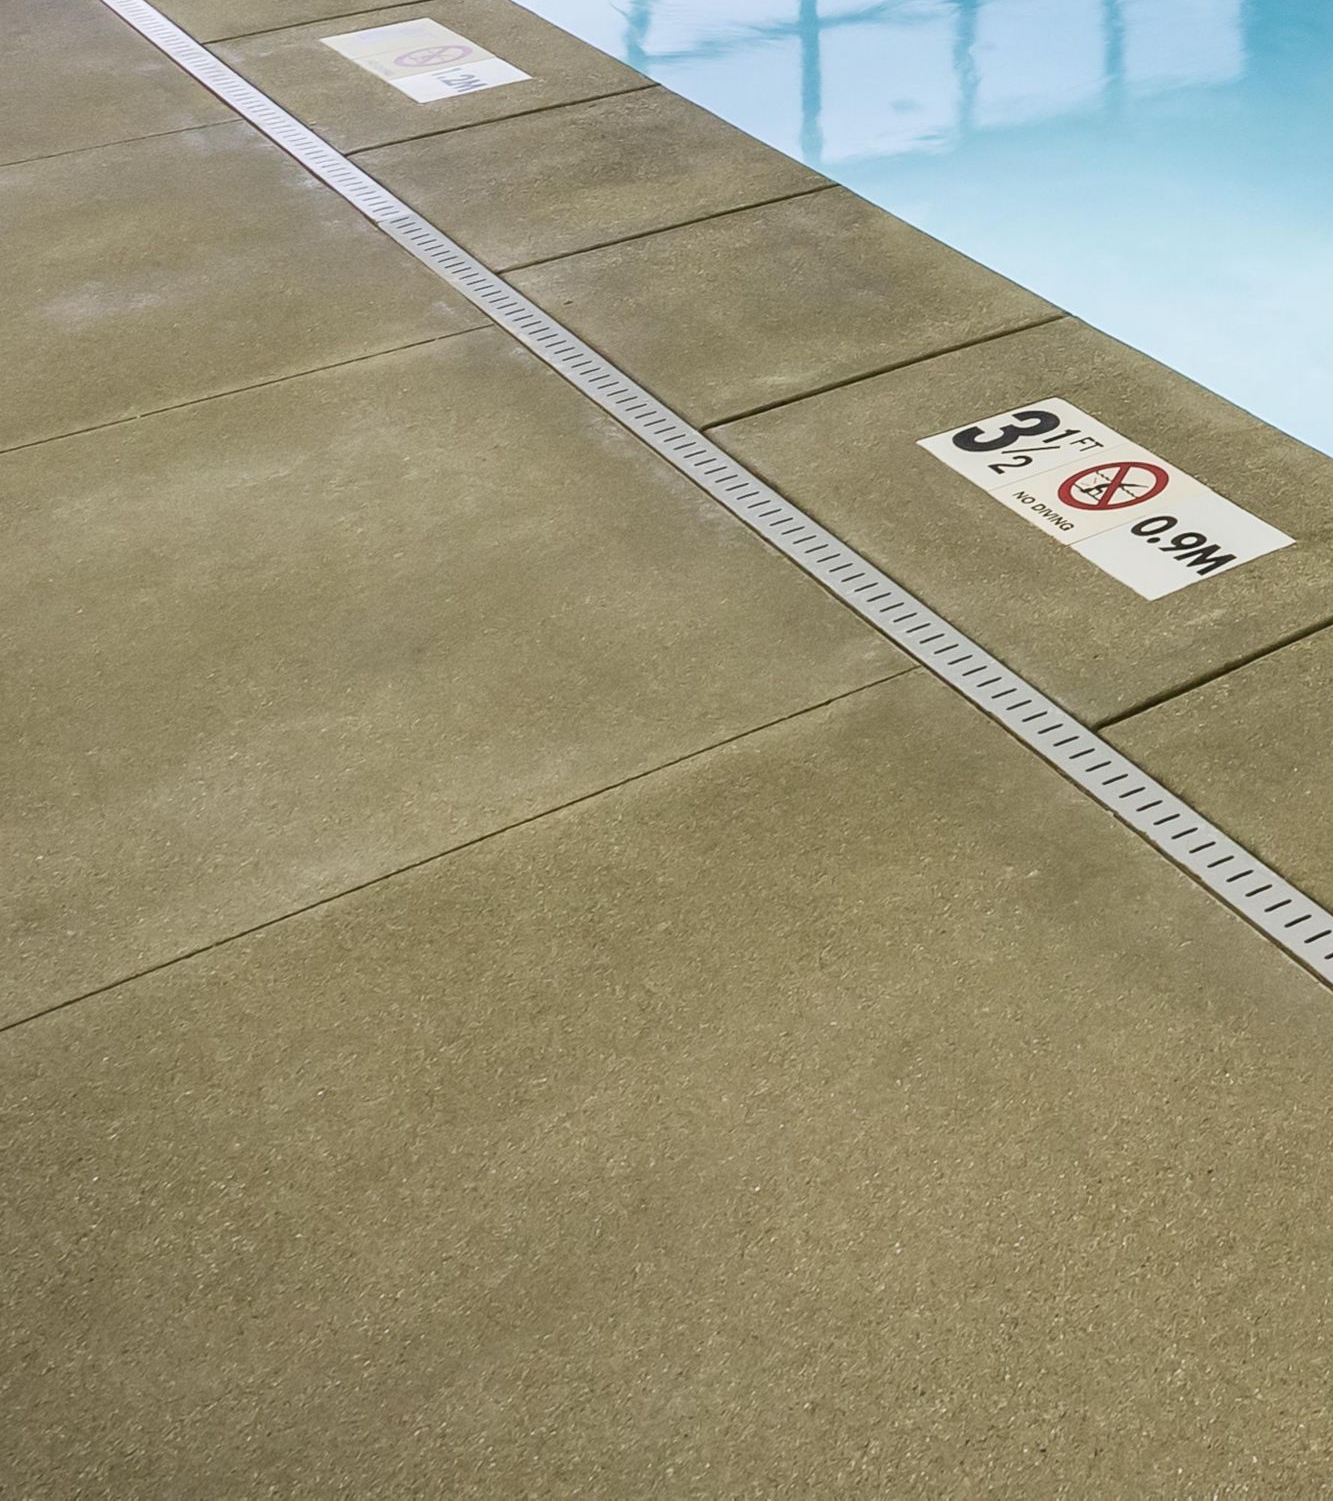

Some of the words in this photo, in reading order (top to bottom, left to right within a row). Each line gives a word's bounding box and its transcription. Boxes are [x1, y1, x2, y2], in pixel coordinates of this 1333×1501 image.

[951, 409, 1061, 453] 3
[1071, 436, 1105, 452] FT
[1012, 490, 1035, 506] NO
[1030, 502, 1075, 533] DIVING
[1130, 514, 1238, 577] 0.9M
